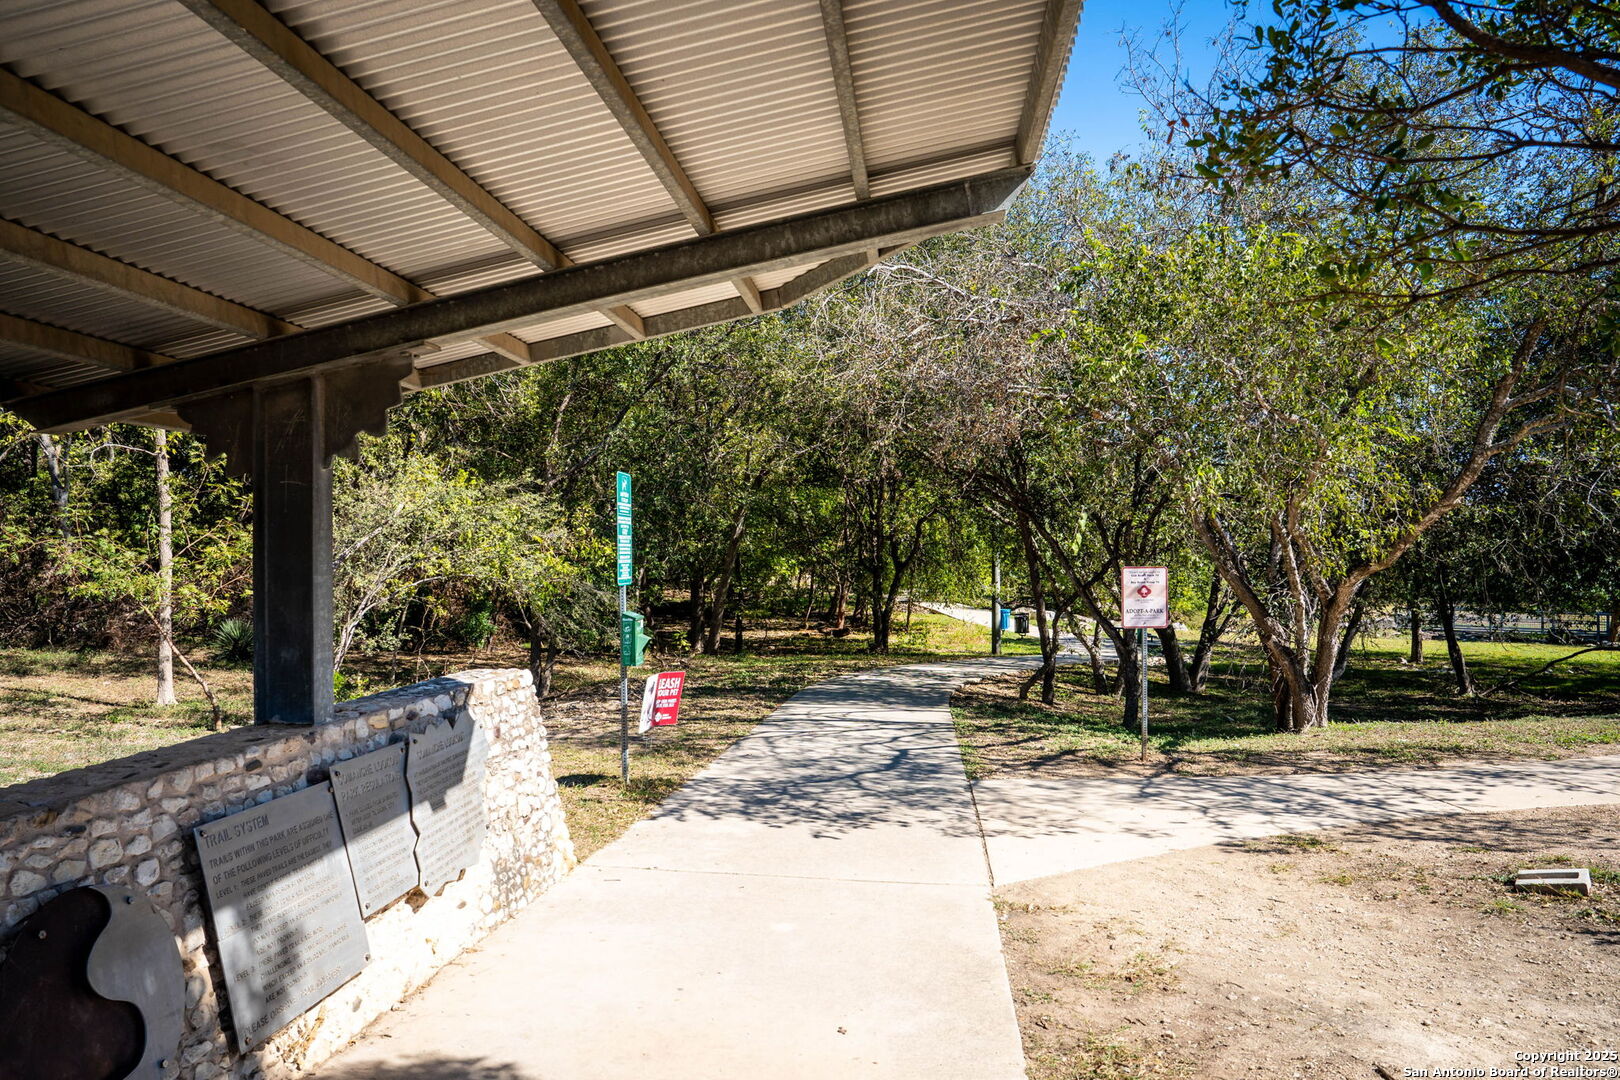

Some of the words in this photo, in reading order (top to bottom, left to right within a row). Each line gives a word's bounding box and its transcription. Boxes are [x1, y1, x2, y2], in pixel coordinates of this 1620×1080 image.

[203, 827, 232, 848] TRAIL
[234, 814, 269, 837] SYSTEM
[209, 852, 233, 868] TRAILS
[234, 843, 255, 858] WITHIN
[256, 837, 268, 848] THIS
[269, 831, 285, 842] PARK
[286, 826, 297, 836] ARE
[212, 874, 223, 884] OF
[224, 868, 235, 879] THE
[236, 852, 271, 873] FOLLOWING
[272, 843, 293, 858] LEVELS
[294, 840, 301, 848] OF
[216, 886, 232, 898] LEVEL
[241, 875, 255, 886] THESE
[256, 868, 271, 879] PAVED
[245, 1014, 268, 1037] PLEASE
